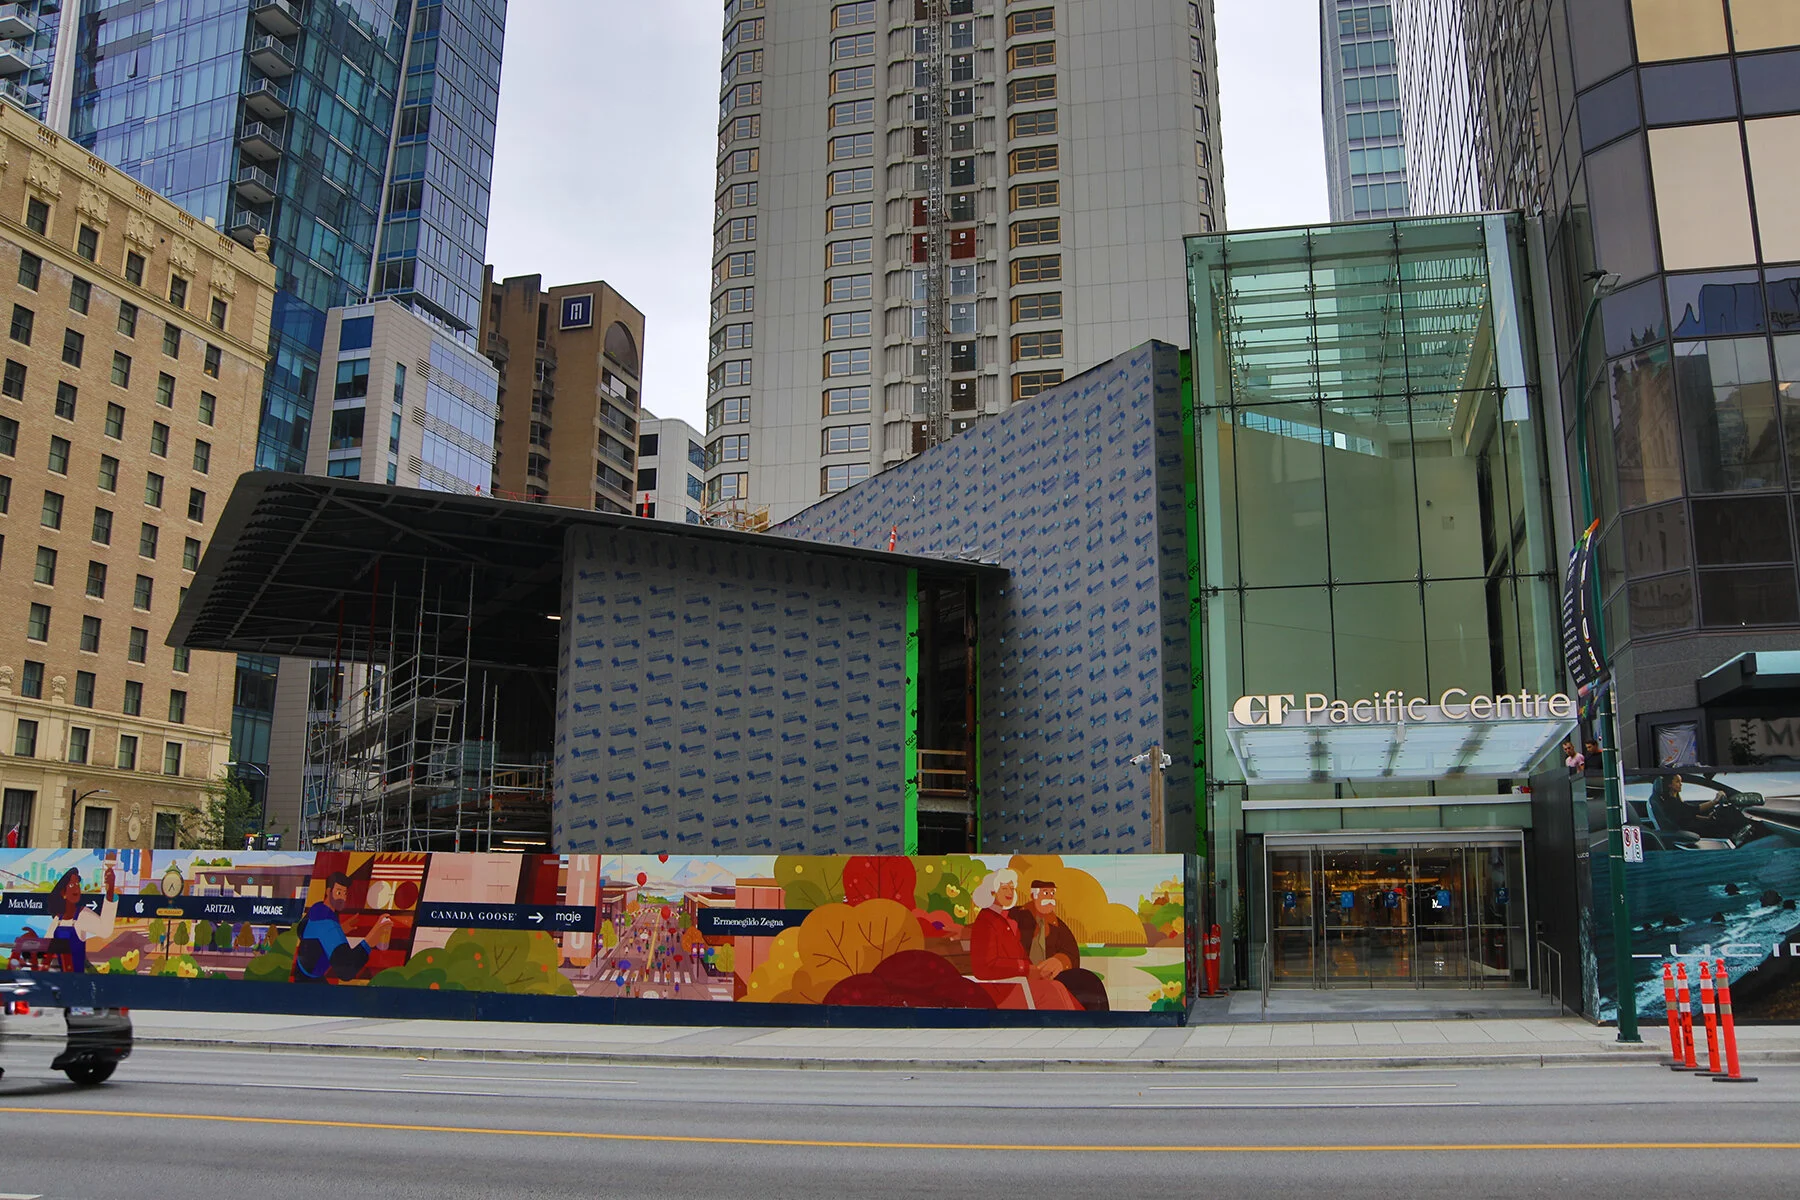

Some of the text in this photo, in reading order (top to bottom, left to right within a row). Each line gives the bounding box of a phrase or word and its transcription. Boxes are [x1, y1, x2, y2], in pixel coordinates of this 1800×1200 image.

[1232, 687, 1572, 726] CF Pacific Centre
[8, 898, 43, 910] MaxMara
[204, 903, 283, 916] ARITZIA MACKAGE
[430, 910, 517, 922] CANADA GOOSE
[555, 910, 582, 923] maje
[712, 916, 784, 929] Ermenegildo Zegna
